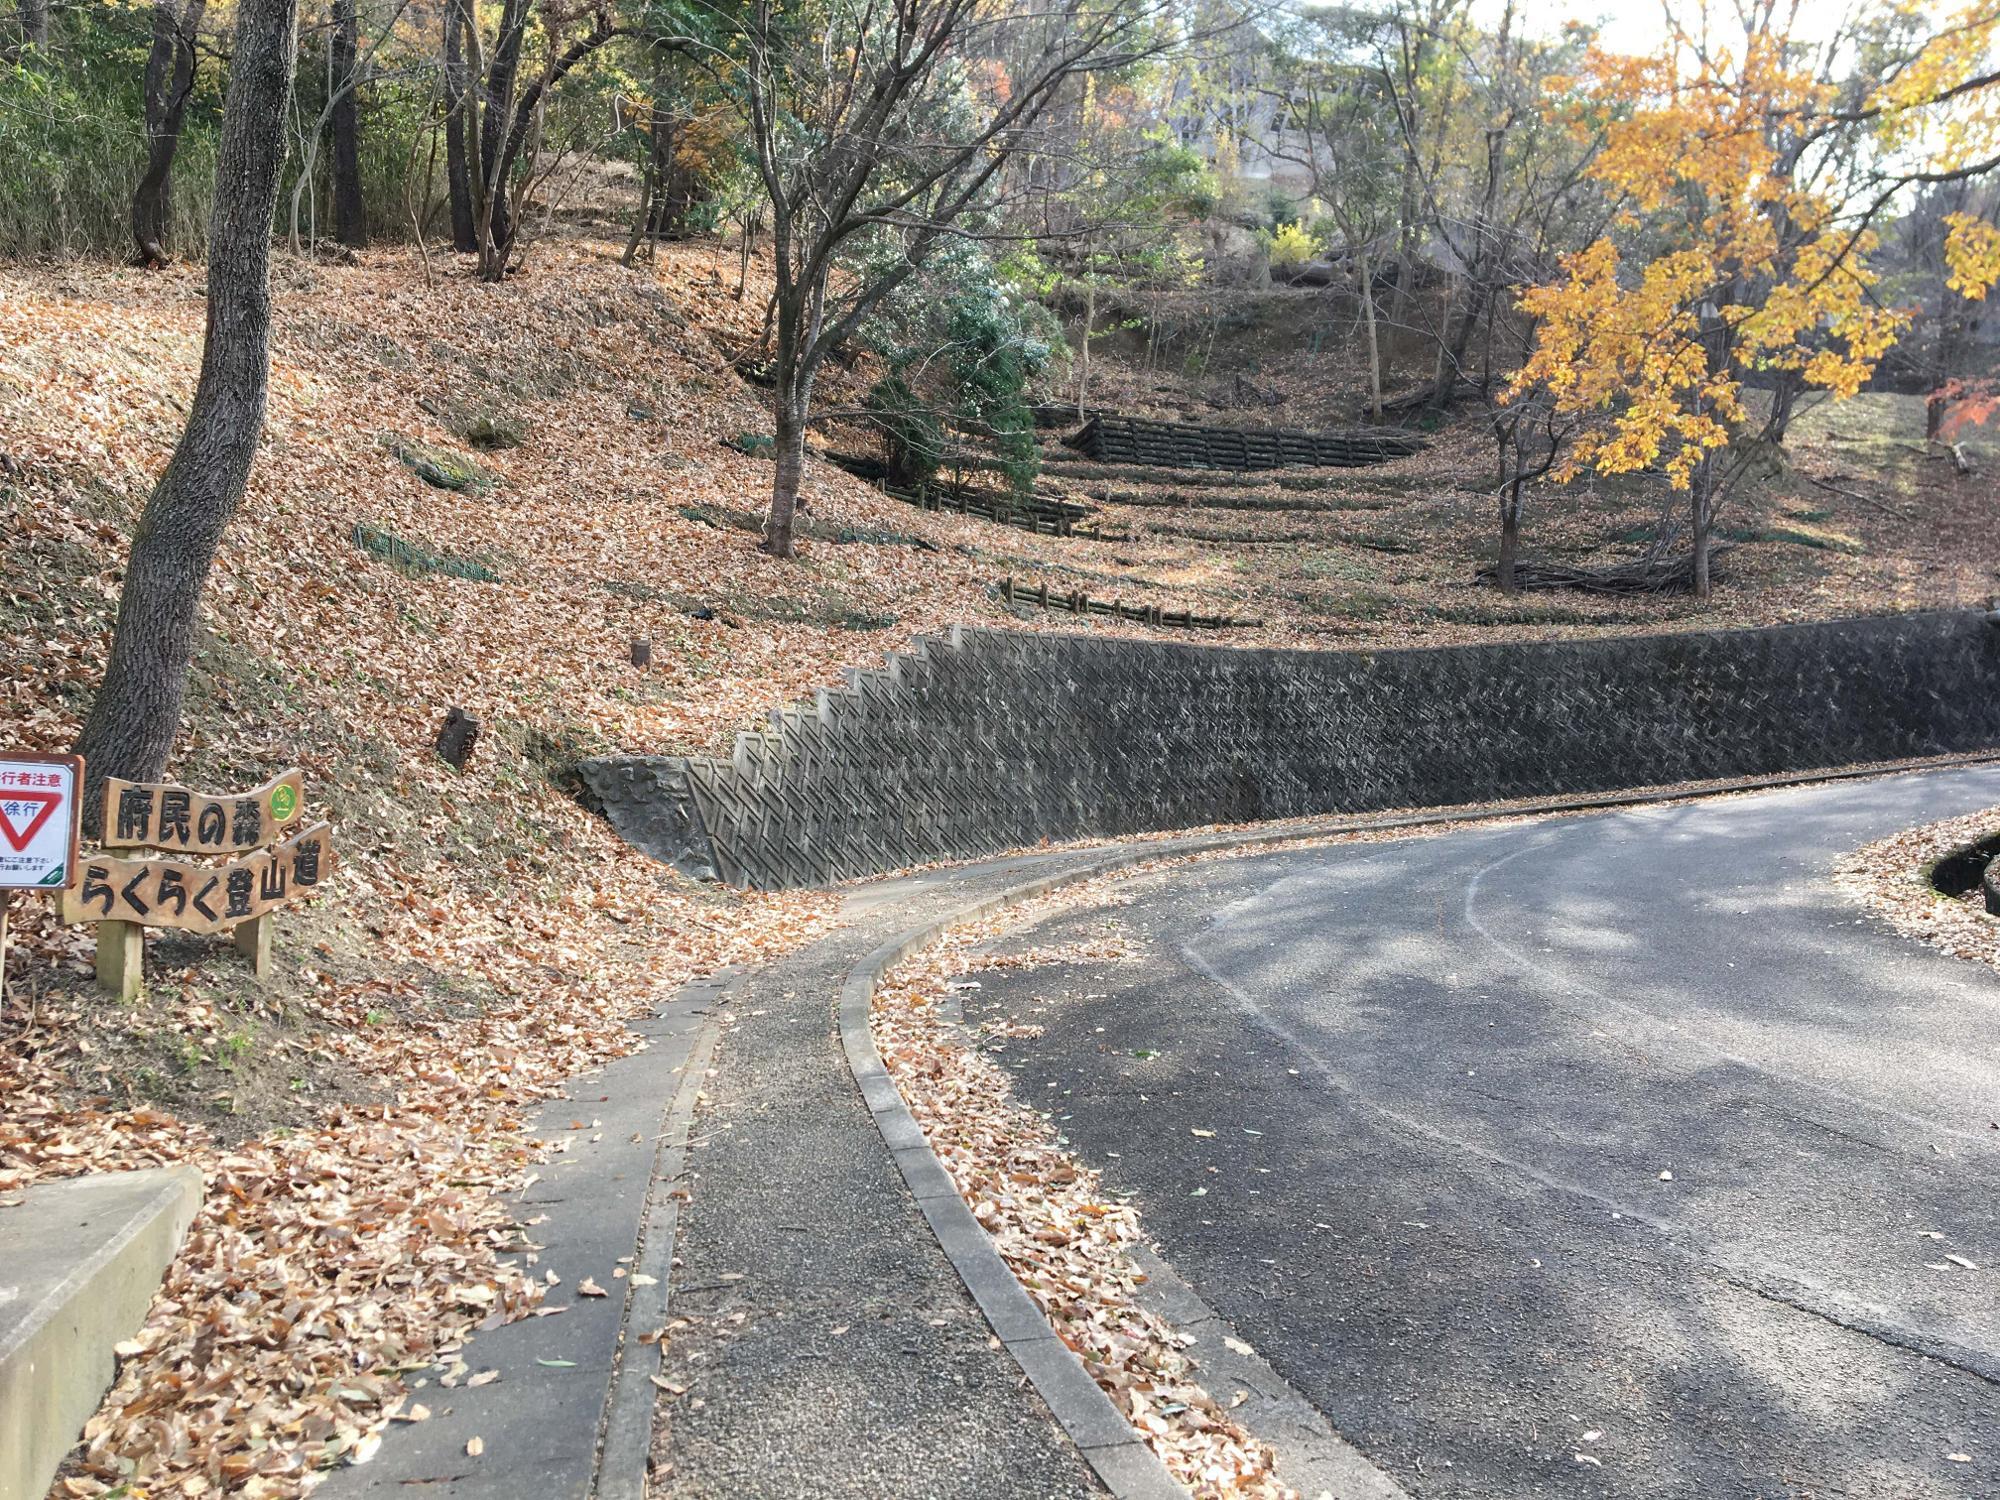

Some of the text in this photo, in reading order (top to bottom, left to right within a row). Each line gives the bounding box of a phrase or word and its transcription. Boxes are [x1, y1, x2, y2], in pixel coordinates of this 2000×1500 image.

[0, 771, 62, 787] 行者注意
[4, 801, 39, 817] 徐行
[118, 787, 260, 845] 府民の森
[82, 840, 321, 922] らくらく登山道
